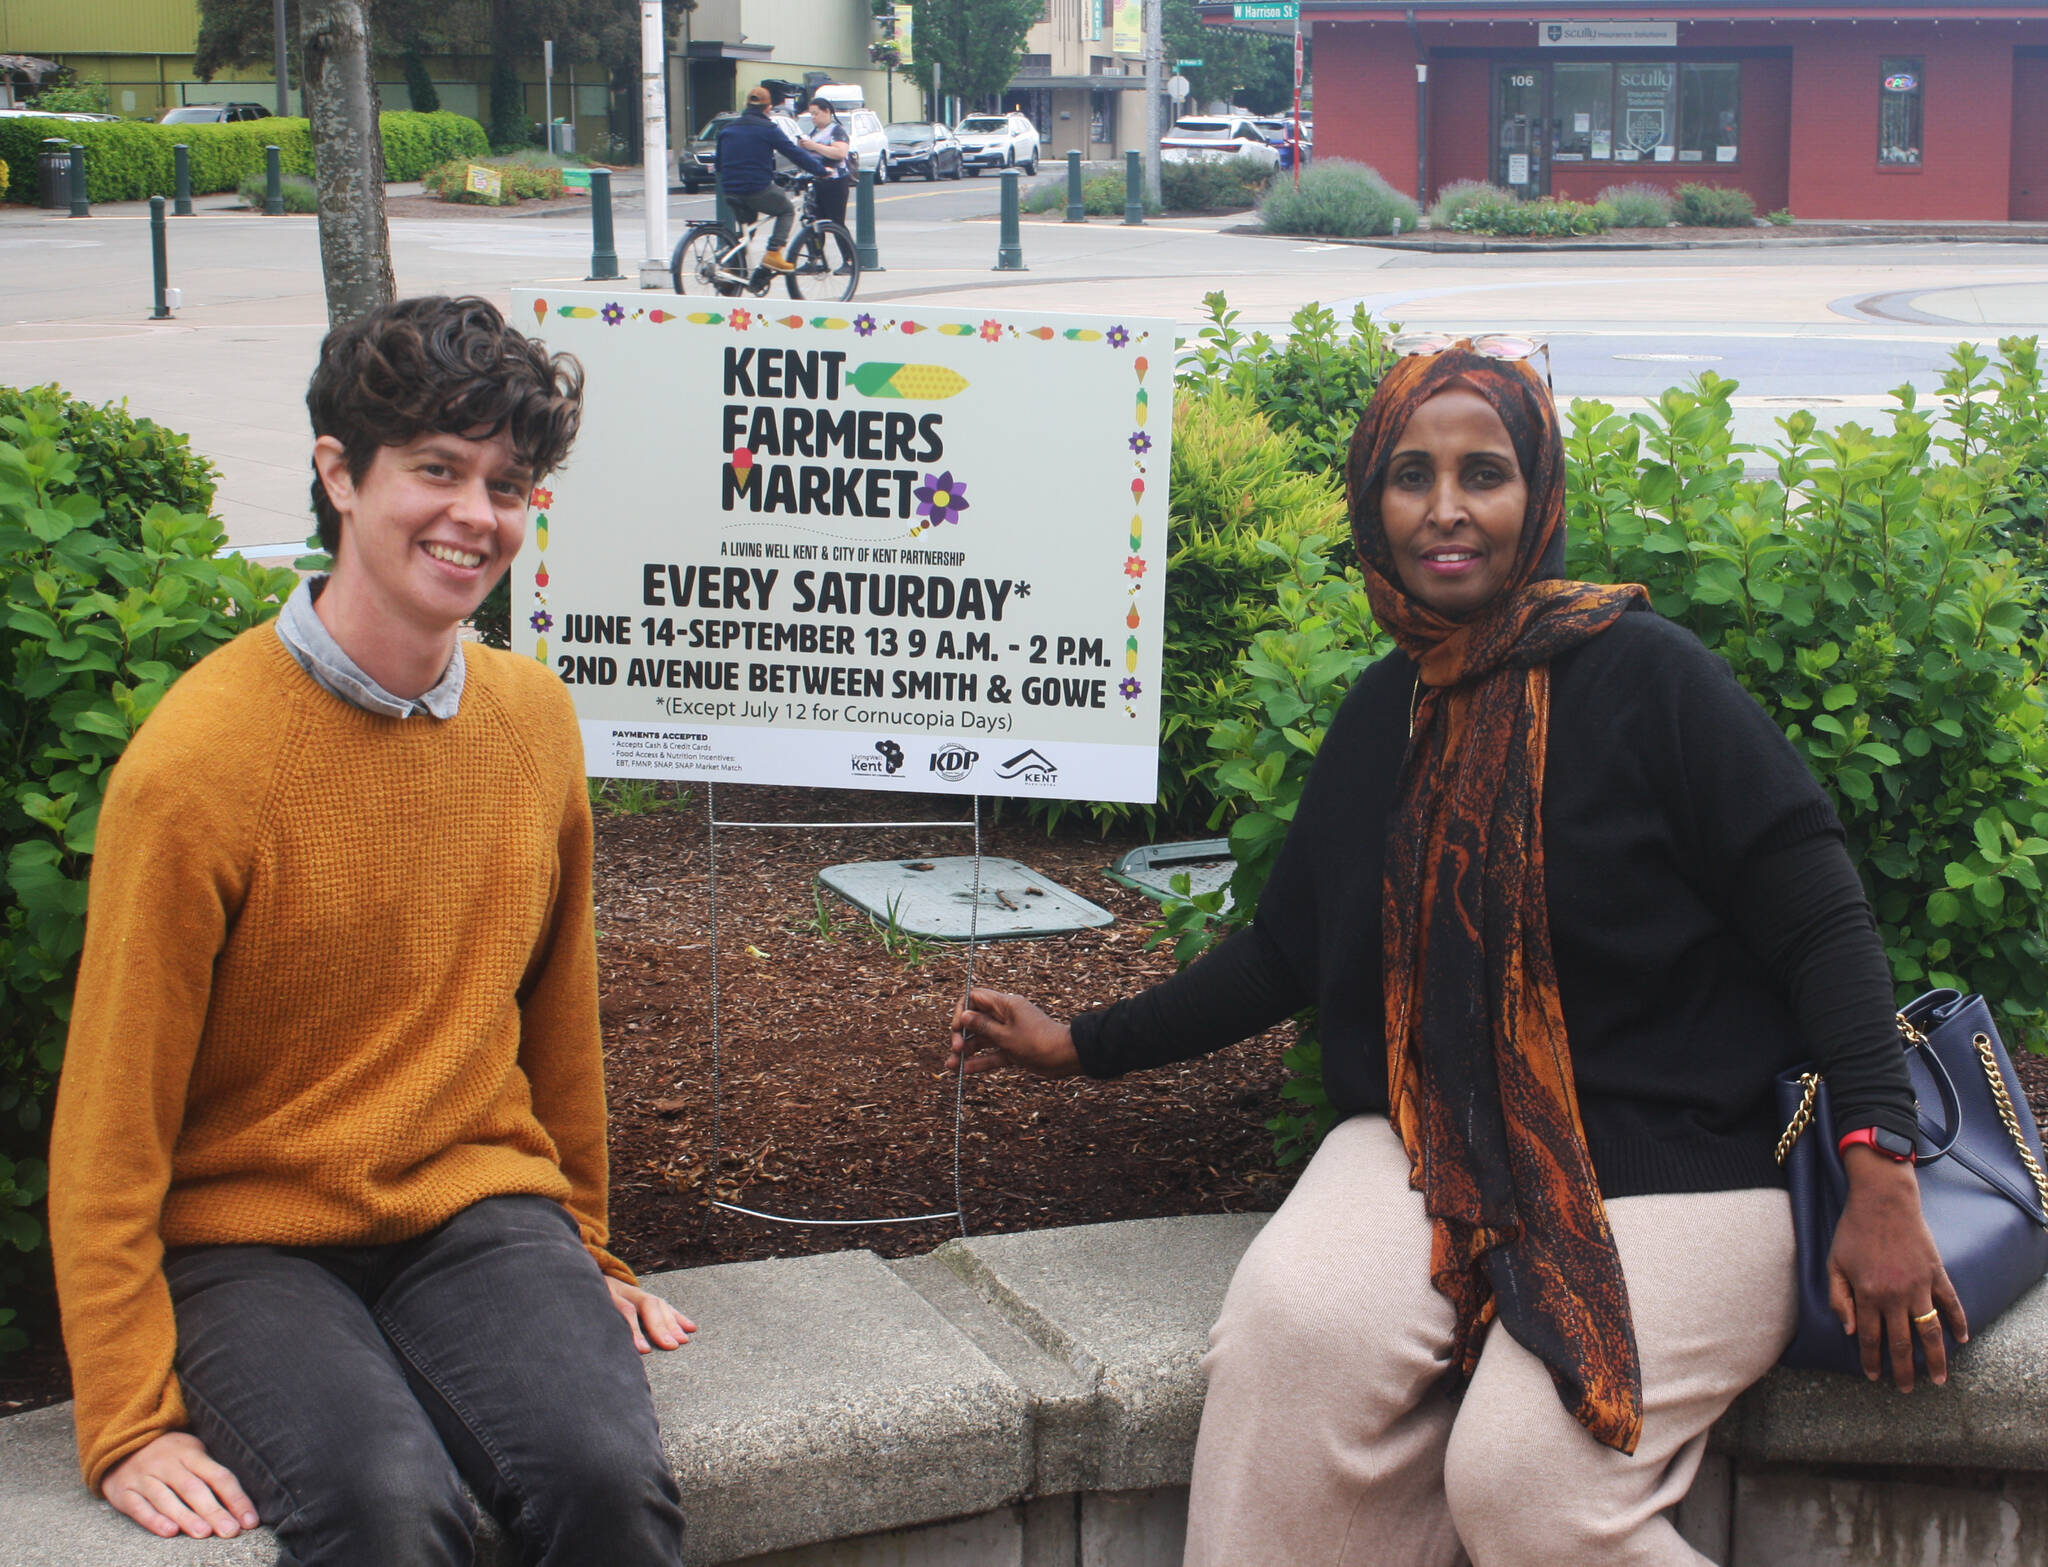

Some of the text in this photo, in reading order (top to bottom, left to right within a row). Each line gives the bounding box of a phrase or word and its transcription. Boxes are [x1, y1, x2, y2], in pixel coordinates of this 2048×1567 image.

[1234, 6, 1294, 18] W Harrison St
[1564, 27, 1597, 41] scully
[1511, 75, 1534, 87] 106
[1620, 69, 1673, 90] scully
[723, 346, 847, 401] KENT
[722, 404, 944, 463] FARMERS
[721, 462, 919, 519] MARKET
[720, 541, 966, 567] A LIVING WELL KENT & CITY OF KENT PARTNERSHIP
[643, 563, 779, 611] EVERY
[561, 613, 1111, 667] JUNE 14-SEPTEMBER 13 9 A.M. - 2 P.M.
[557, 655, 1107, 709] 2ND AVENUE BETWEEN SMITH & GOWE
[740, 700, 779, 723] July
[784, 703, 807, 720] 12
[812, 702, 839, 722] for
[844, 705, 955, 729] Cornucopia
[961, 710, 1013, 733] Days)
[612, 730, 708, 741] PAYMENTS ACCEPTED
[616, 741, 643, 749] Accepts
[645, 741, 661, 749] Cash
[669, 742, 691, 751] Credit
[692, 743, 712, 751] Cards
[616, 750, 634, 758] Food
[635, 751, 658, 759] Access
[666, 752, 698, 760] Nutrition
[699, 753, 736, 762] Incentives:
[616, 760, 630, 768] EBT,
[631, 760, 652, 769] FMNP,
[653, 761, 673, 769] SNAP,
[695, 762, 720, 770] Market
[721, 763, 743, 772] Match
[851, 759, 883, 772] Kent
[929, 751, 980, 772] KDP
[1024, 773, 1058, 783] KENT
